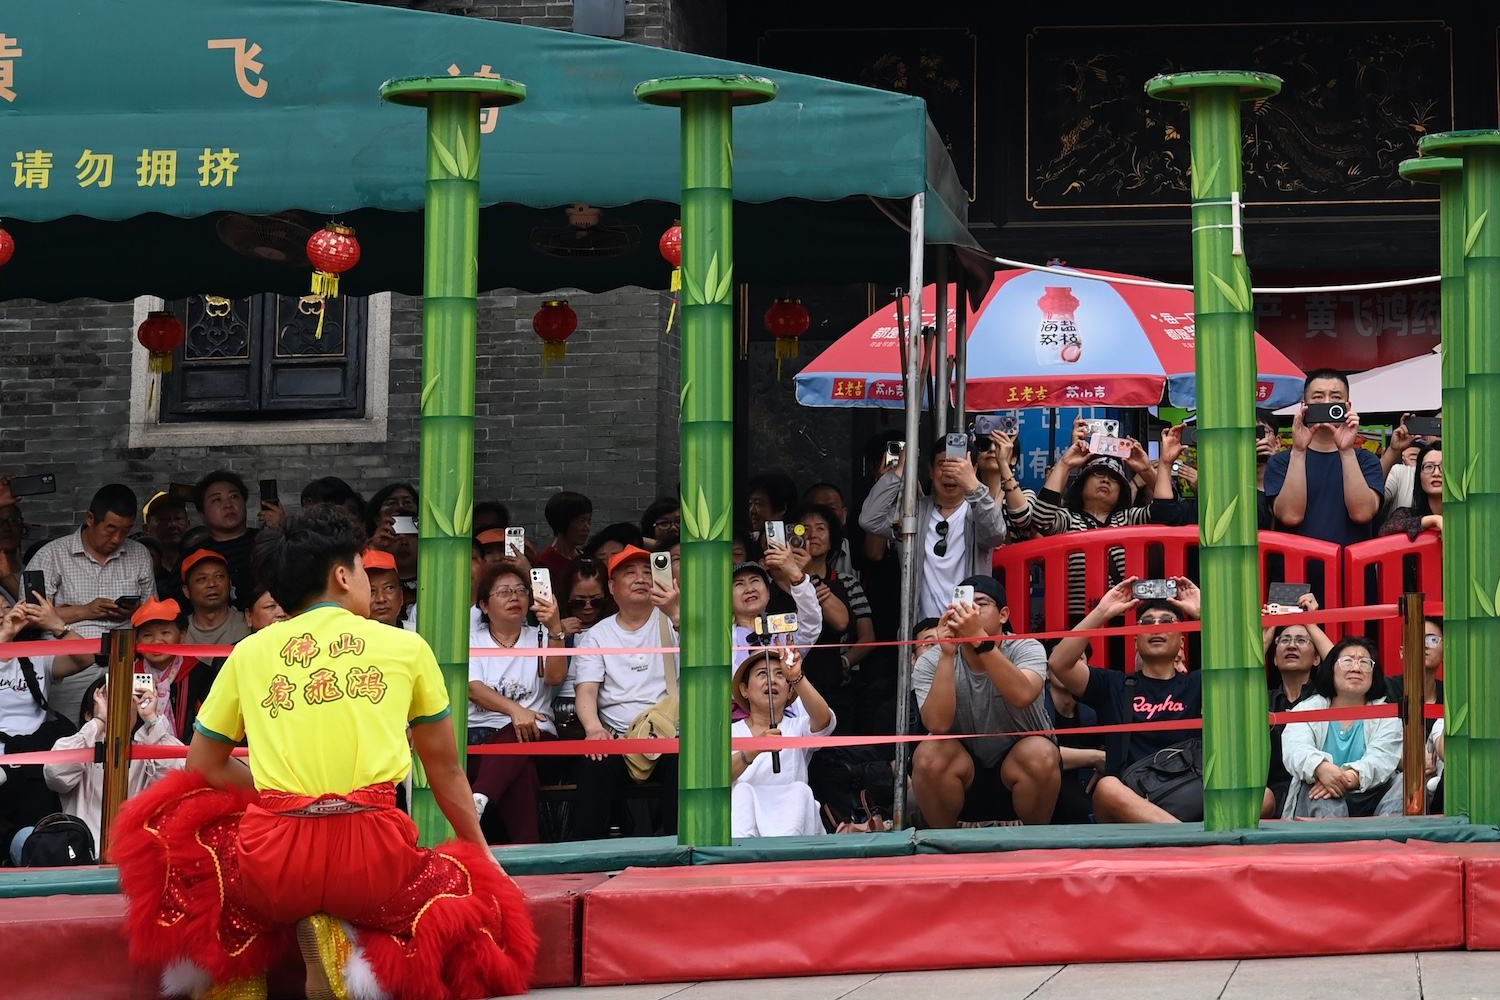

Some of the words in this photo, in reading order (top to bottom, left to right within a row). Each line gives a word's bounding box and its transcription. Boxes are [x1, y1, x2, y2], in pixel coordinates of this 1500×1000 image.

[11, 147, 240, 189] 请勿拥挤
[834, 381, 864, 397] 王老吉
[1006, 386, 1049, 402] 王老吉
[280, 633, 365, 668] 佛山
[1133, 694, 1184, 719] Rapha
